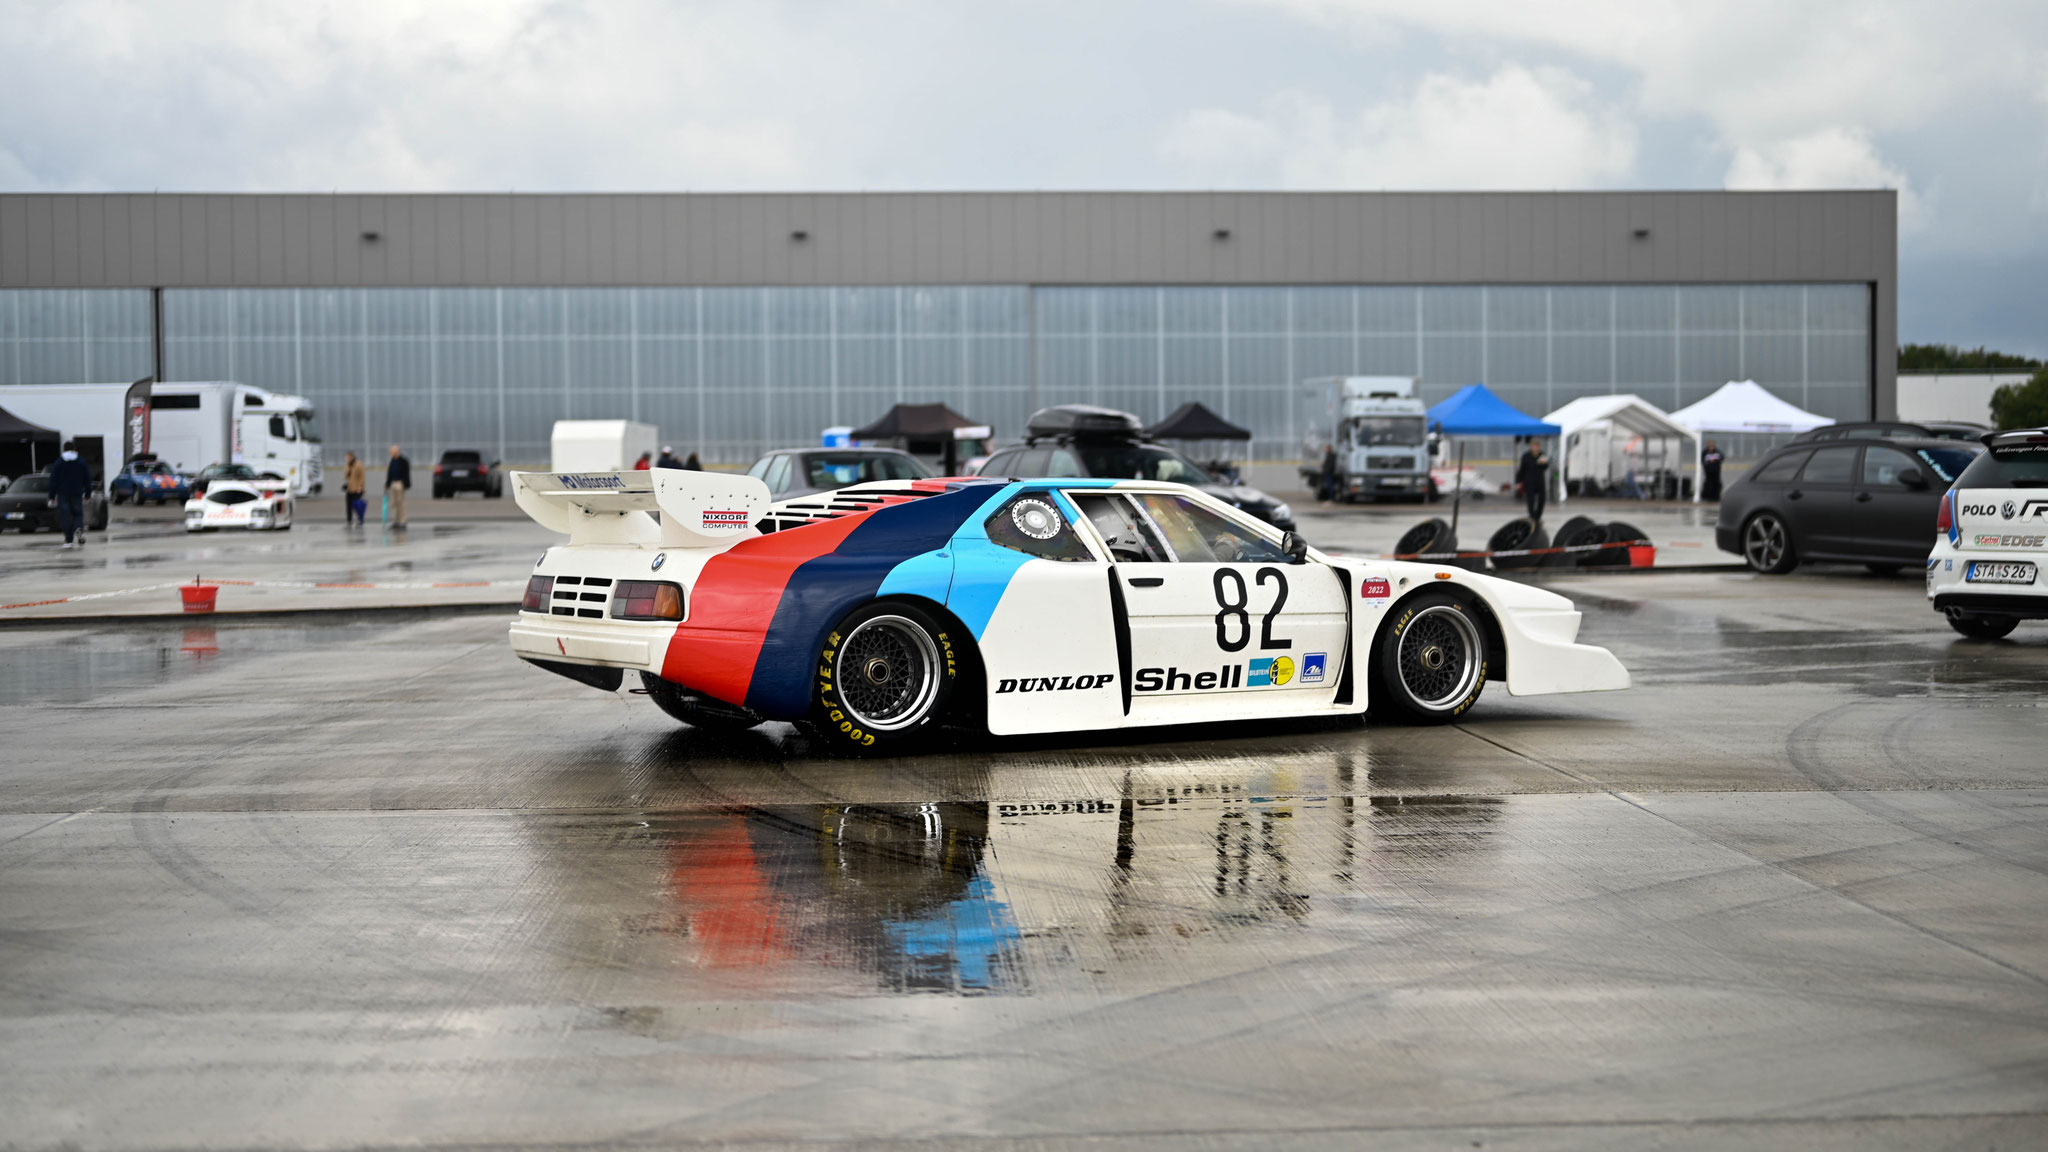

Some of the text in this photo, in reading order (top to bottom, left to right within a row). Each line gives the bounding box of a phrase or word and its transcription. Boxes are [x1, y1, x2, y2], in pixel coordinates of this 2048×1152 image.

[570, 474, 626, 490] Motorsport
[1962, 505, 1996, 516] POLO
[2001, 535, 2046, 547] EDGE
[1974, 563, 1995, 578] STA
[1368, 586, 1385, 594] 2022
[1213, 566, 1292, 653] 82
[1395, 608, 1414, 636] EAGLE
[938, 632, 956, 677] EAGLE
[995, 674, 1114, 694] DUNLOP
[1134, 664, 1243, 692] Shell
